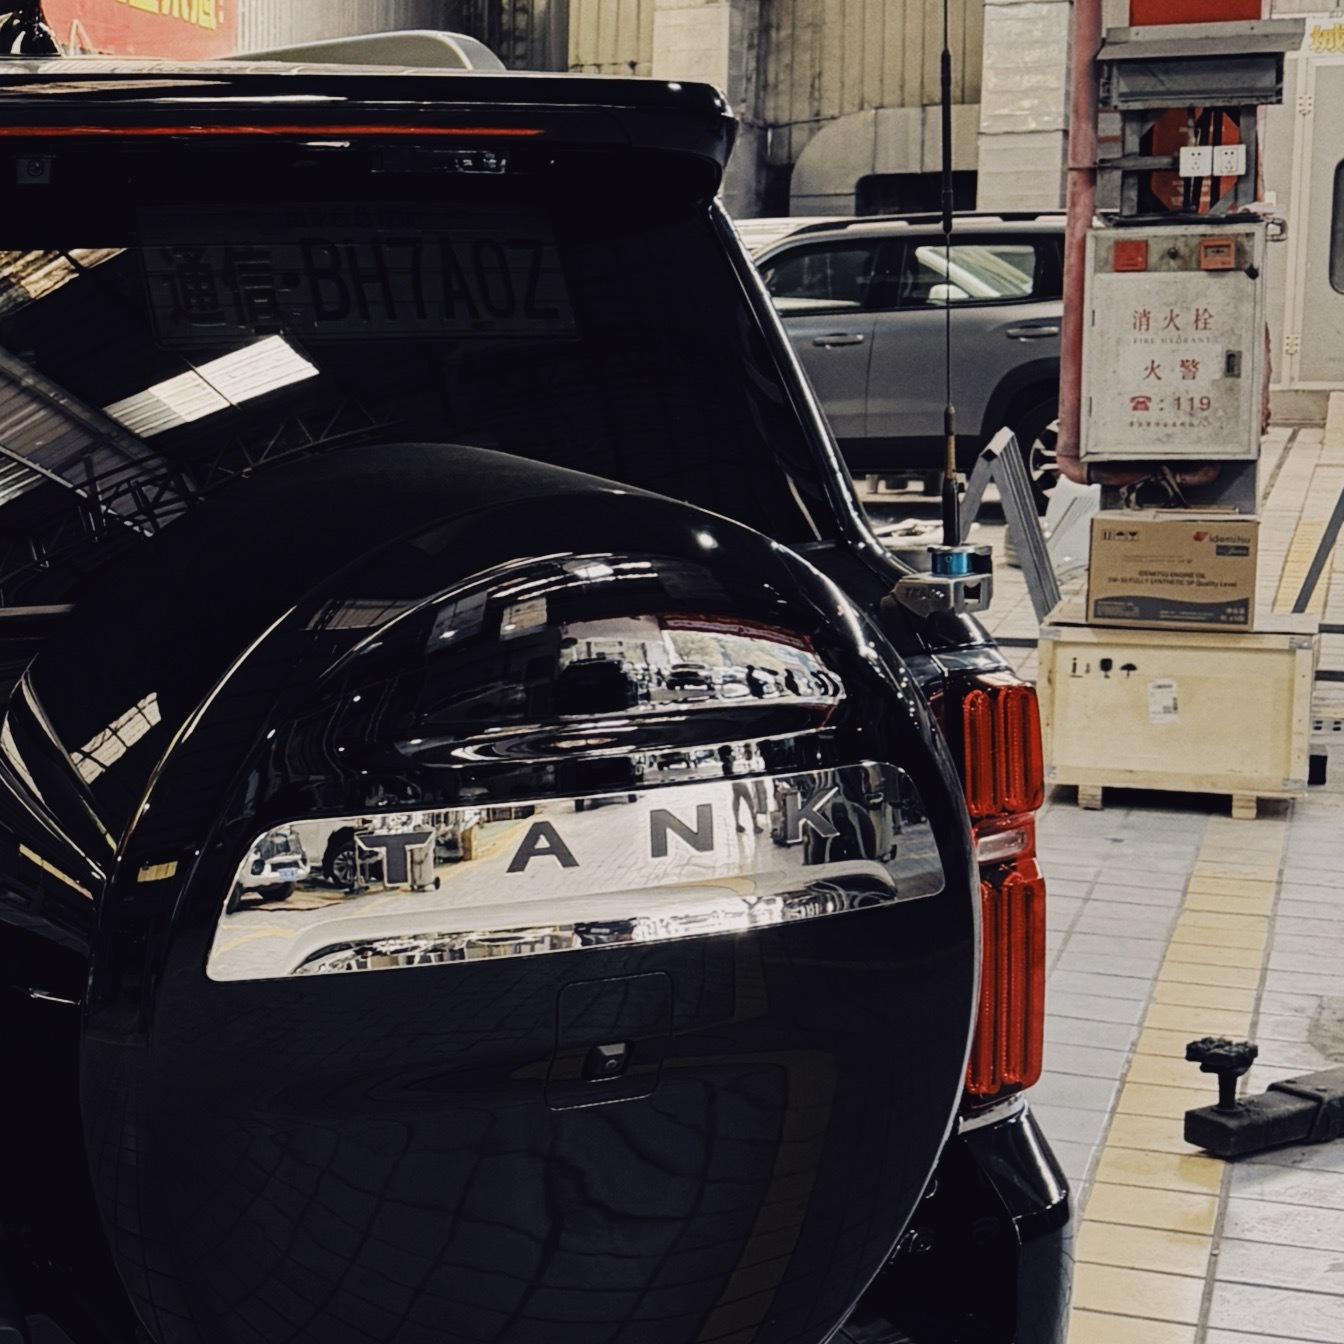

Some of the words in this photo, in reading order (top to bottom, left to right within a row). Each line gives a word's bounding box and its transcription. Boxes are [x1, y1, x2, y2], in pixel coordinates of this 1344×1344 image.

[1132, 308, 1214, 332] 消火栓
[1143, 359, 1200, 381] 火警
[356, 786, 841, 888] TANK
